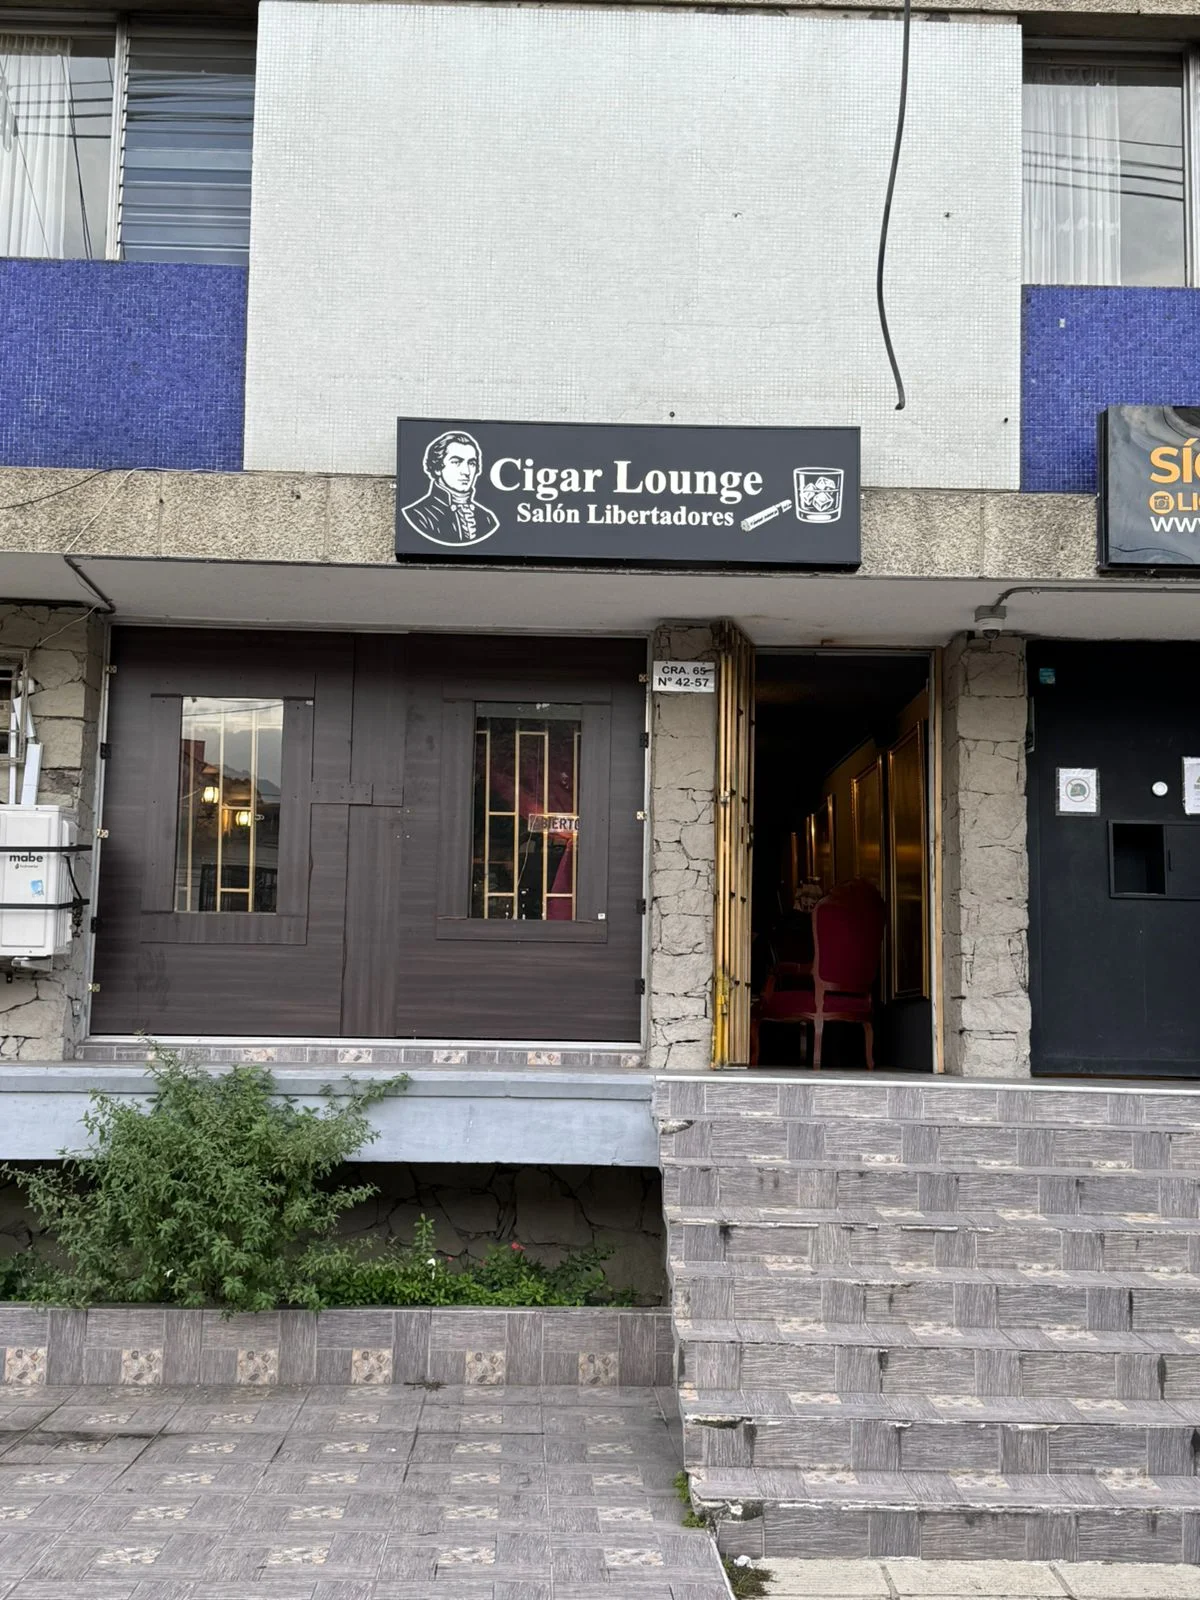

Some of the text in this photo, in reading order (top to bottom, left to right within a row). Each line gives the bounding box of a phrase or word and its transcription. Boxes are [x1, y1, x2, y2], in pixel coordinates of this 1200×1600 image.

[1150, 438, 1200, 484] SÍ
[489, 457, 763, 504] Cigar Lounge
[1177, 492, 1200, 512] LI
[516, 503, 735, 527] Salón Libertadores
[662, 666, 706, 675] CRA. 65
[675, 677, 709, 687] 42-57
[9, 852, 44, 862] mabe
